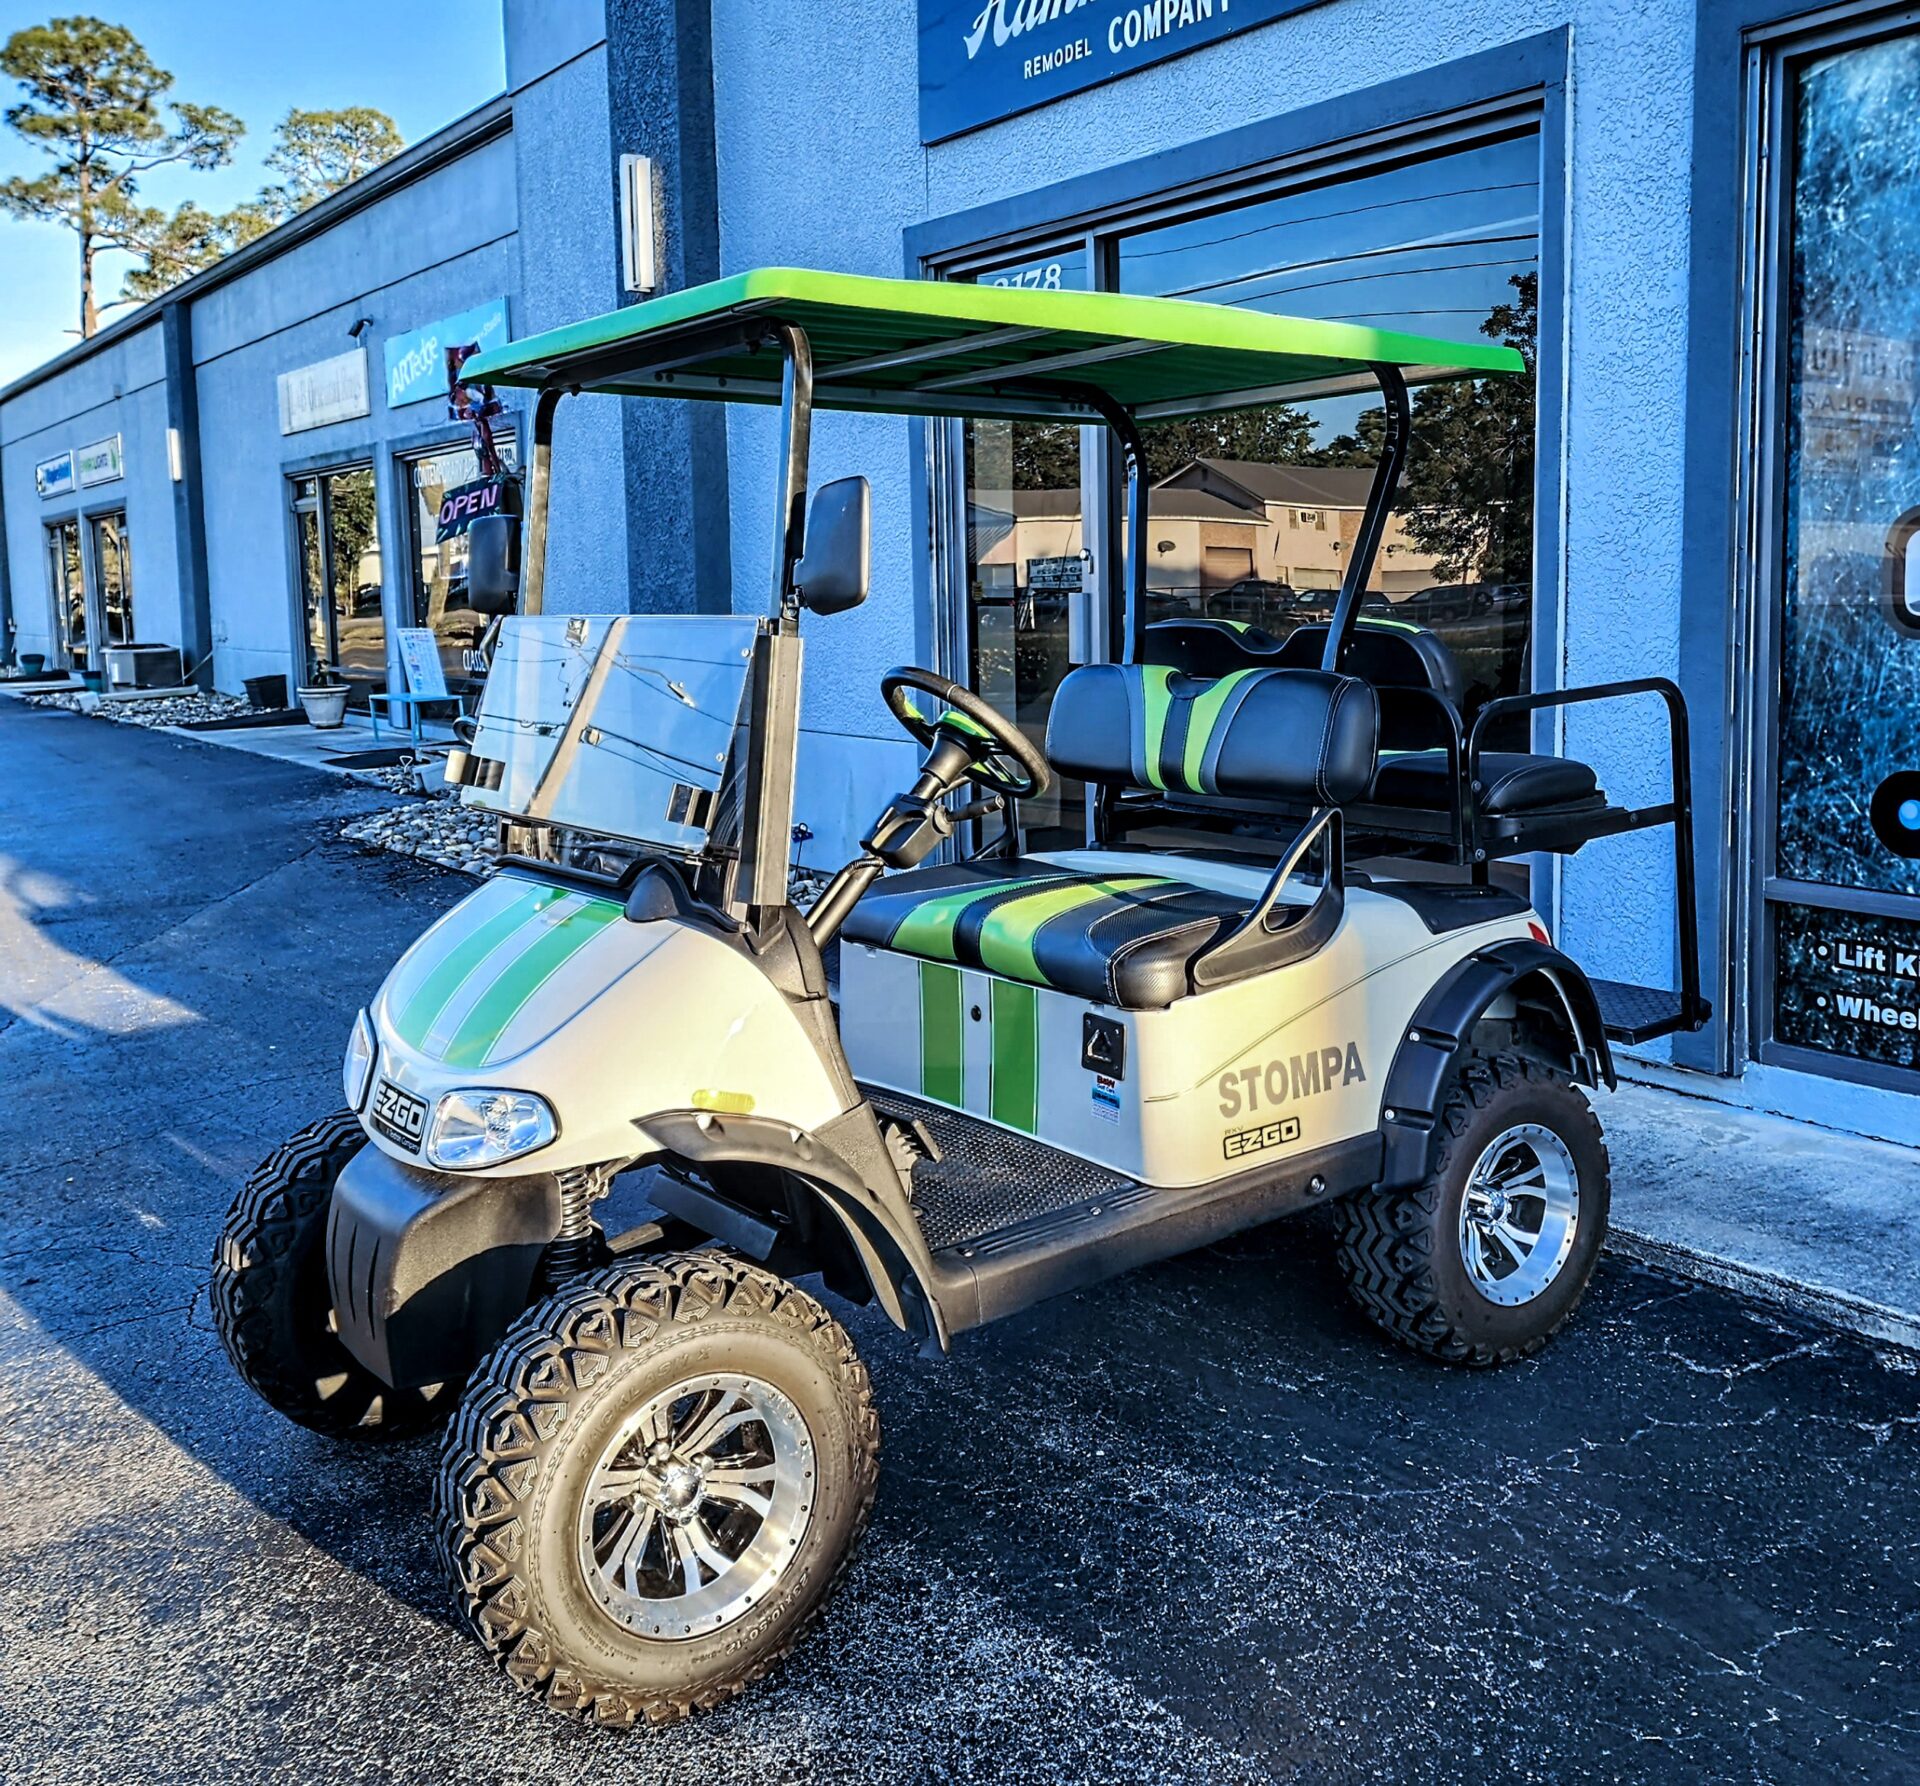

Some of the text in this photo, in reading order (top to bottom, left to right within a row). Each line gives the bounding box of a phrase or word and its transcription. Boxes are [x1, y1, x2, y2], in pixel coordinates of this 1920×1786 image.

[1023, 37, 1093, 79] REMODEL
[440, 484, 498, 525] OPEN
[1838, 943, 1920, 977] Lift K
[1218, 1041, 1367, 1118] STOMPA
[1223, 1116, 1301, 1160] EZGO
